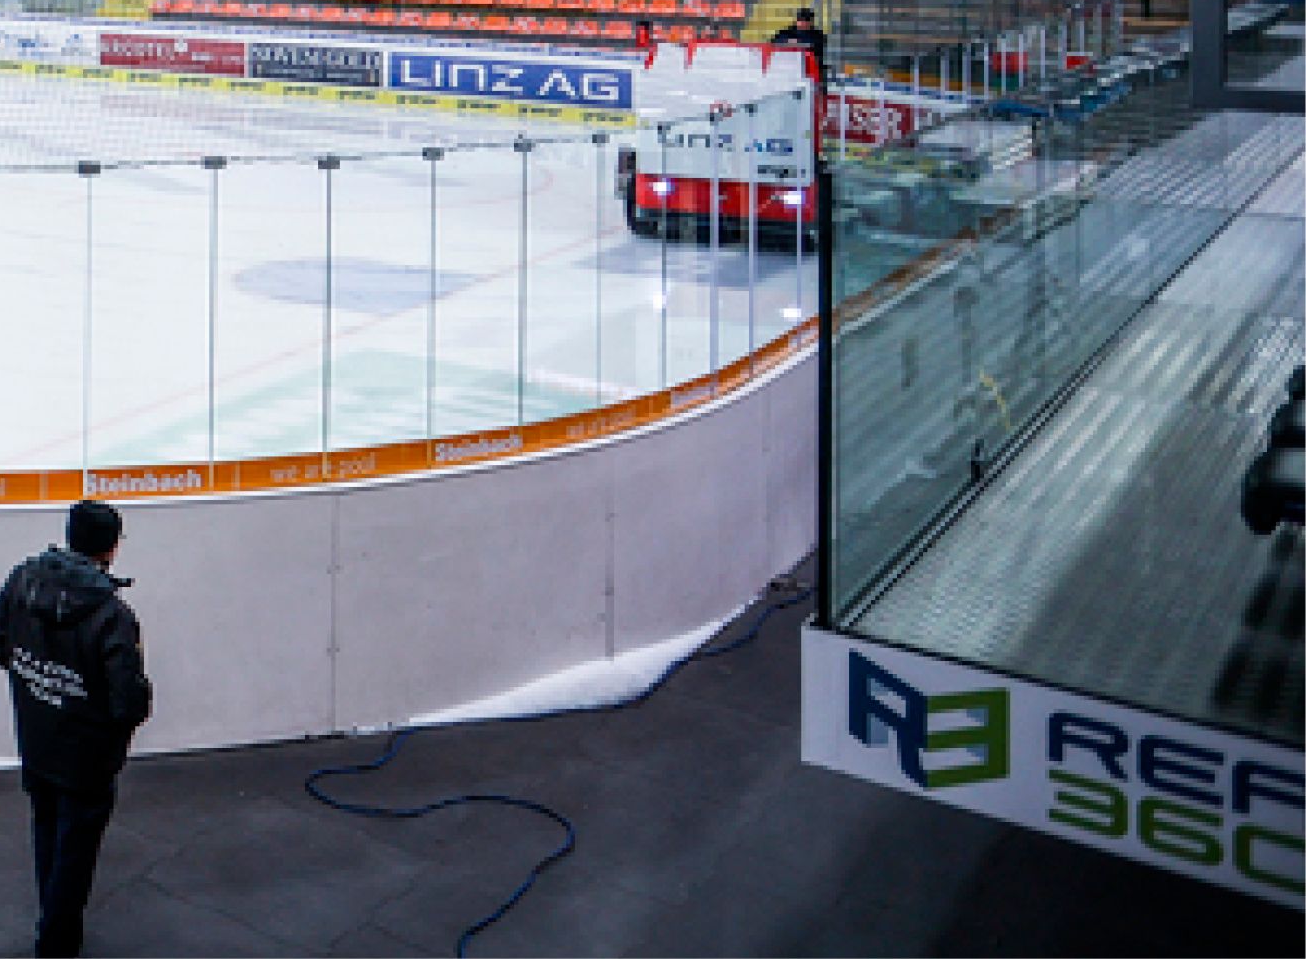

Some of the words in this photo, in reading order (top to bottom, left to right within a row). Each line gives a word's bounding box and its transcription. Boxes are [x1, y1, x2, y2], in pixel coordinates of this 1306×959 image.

[399, 57, 524, 95] LINZ
[534, 70, 621, 102] AG
[83, 469, 201, 496] Steinbach
